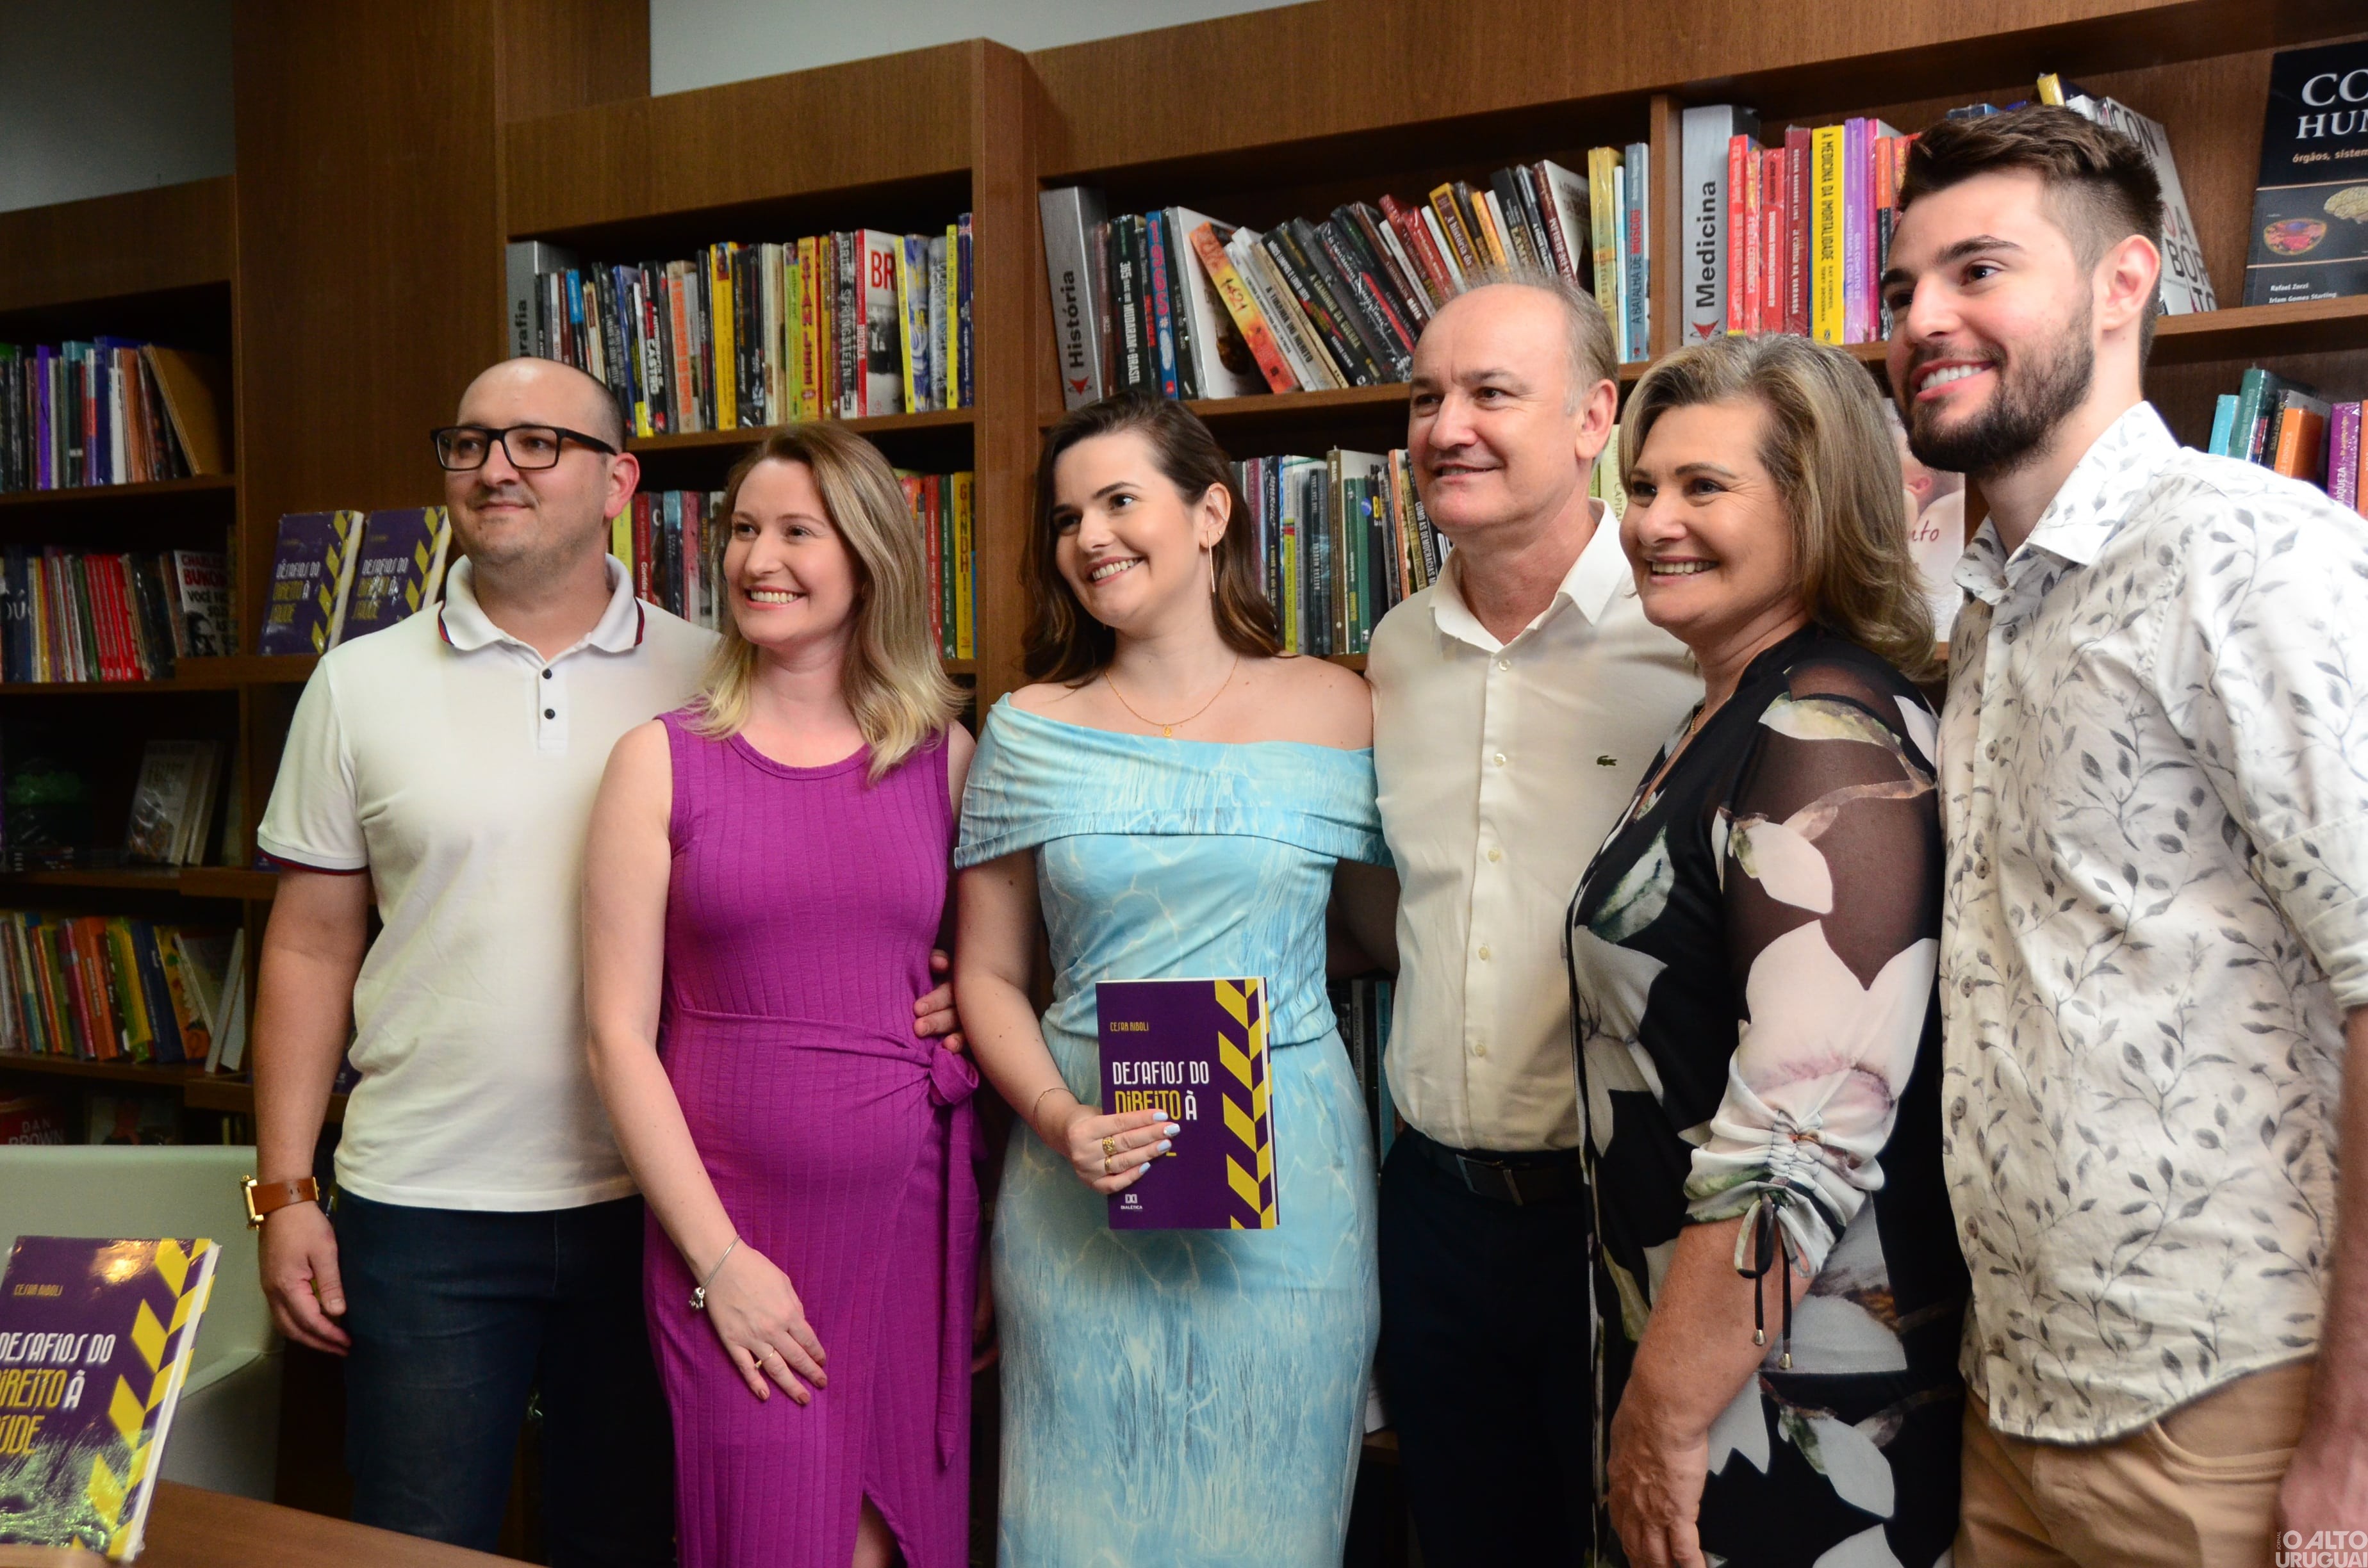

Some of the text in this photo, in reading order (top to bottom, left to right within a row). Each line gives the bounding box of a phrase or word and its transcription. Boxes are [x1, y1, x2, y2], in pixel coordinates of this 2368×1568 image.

[1821, 141, 1834, 183] MEDICINA
[1821, 186, 1834, 197] DA
[1443, 213, 1474, 266] A história do
[1697, 181, 1716, 309] Medicina
[1821, 199, 1834, 261] IMORTALIDADE
[1119, 261, 1132, 280] 365
[1632, 256, 1641, 274] DE
[1632, 274, 1641, 313] BATALHA
[2270, 282, 2309, 292] Rafael Zorzi
[2288, 293, 2309, 302] Gomes
[802, 255, 812, 385] STAN LEE
[841, 238, 852, 377] BRUCE SPRINGSTEEN
[1060, 270, 1084, 368] História
[1632, 313, 1641, 324] A
[1123, 303, 1138, 348] MUDARAM
[857, 323, 866, 360] BRIZOLA
[646, 338, 659, 395] CASTRO
[1127, 353, 1140, 385] BRASIL
[1414, 501, 1425, 521] COMO
[1418, 521, 1427, 530] AS
[1420, 530, 1435, 576] DEMOCRACIAS
[1110, 1022, 1149, 1031] CESAR RIBOLI
[1112, 1061, 1210, 1085] DESAFIOS DO
[1115, 1090, 1197, 1120] DIREITO À
[22, 1117, 51, 1132] DAN
[86, 1334, 117, 1363] DO
